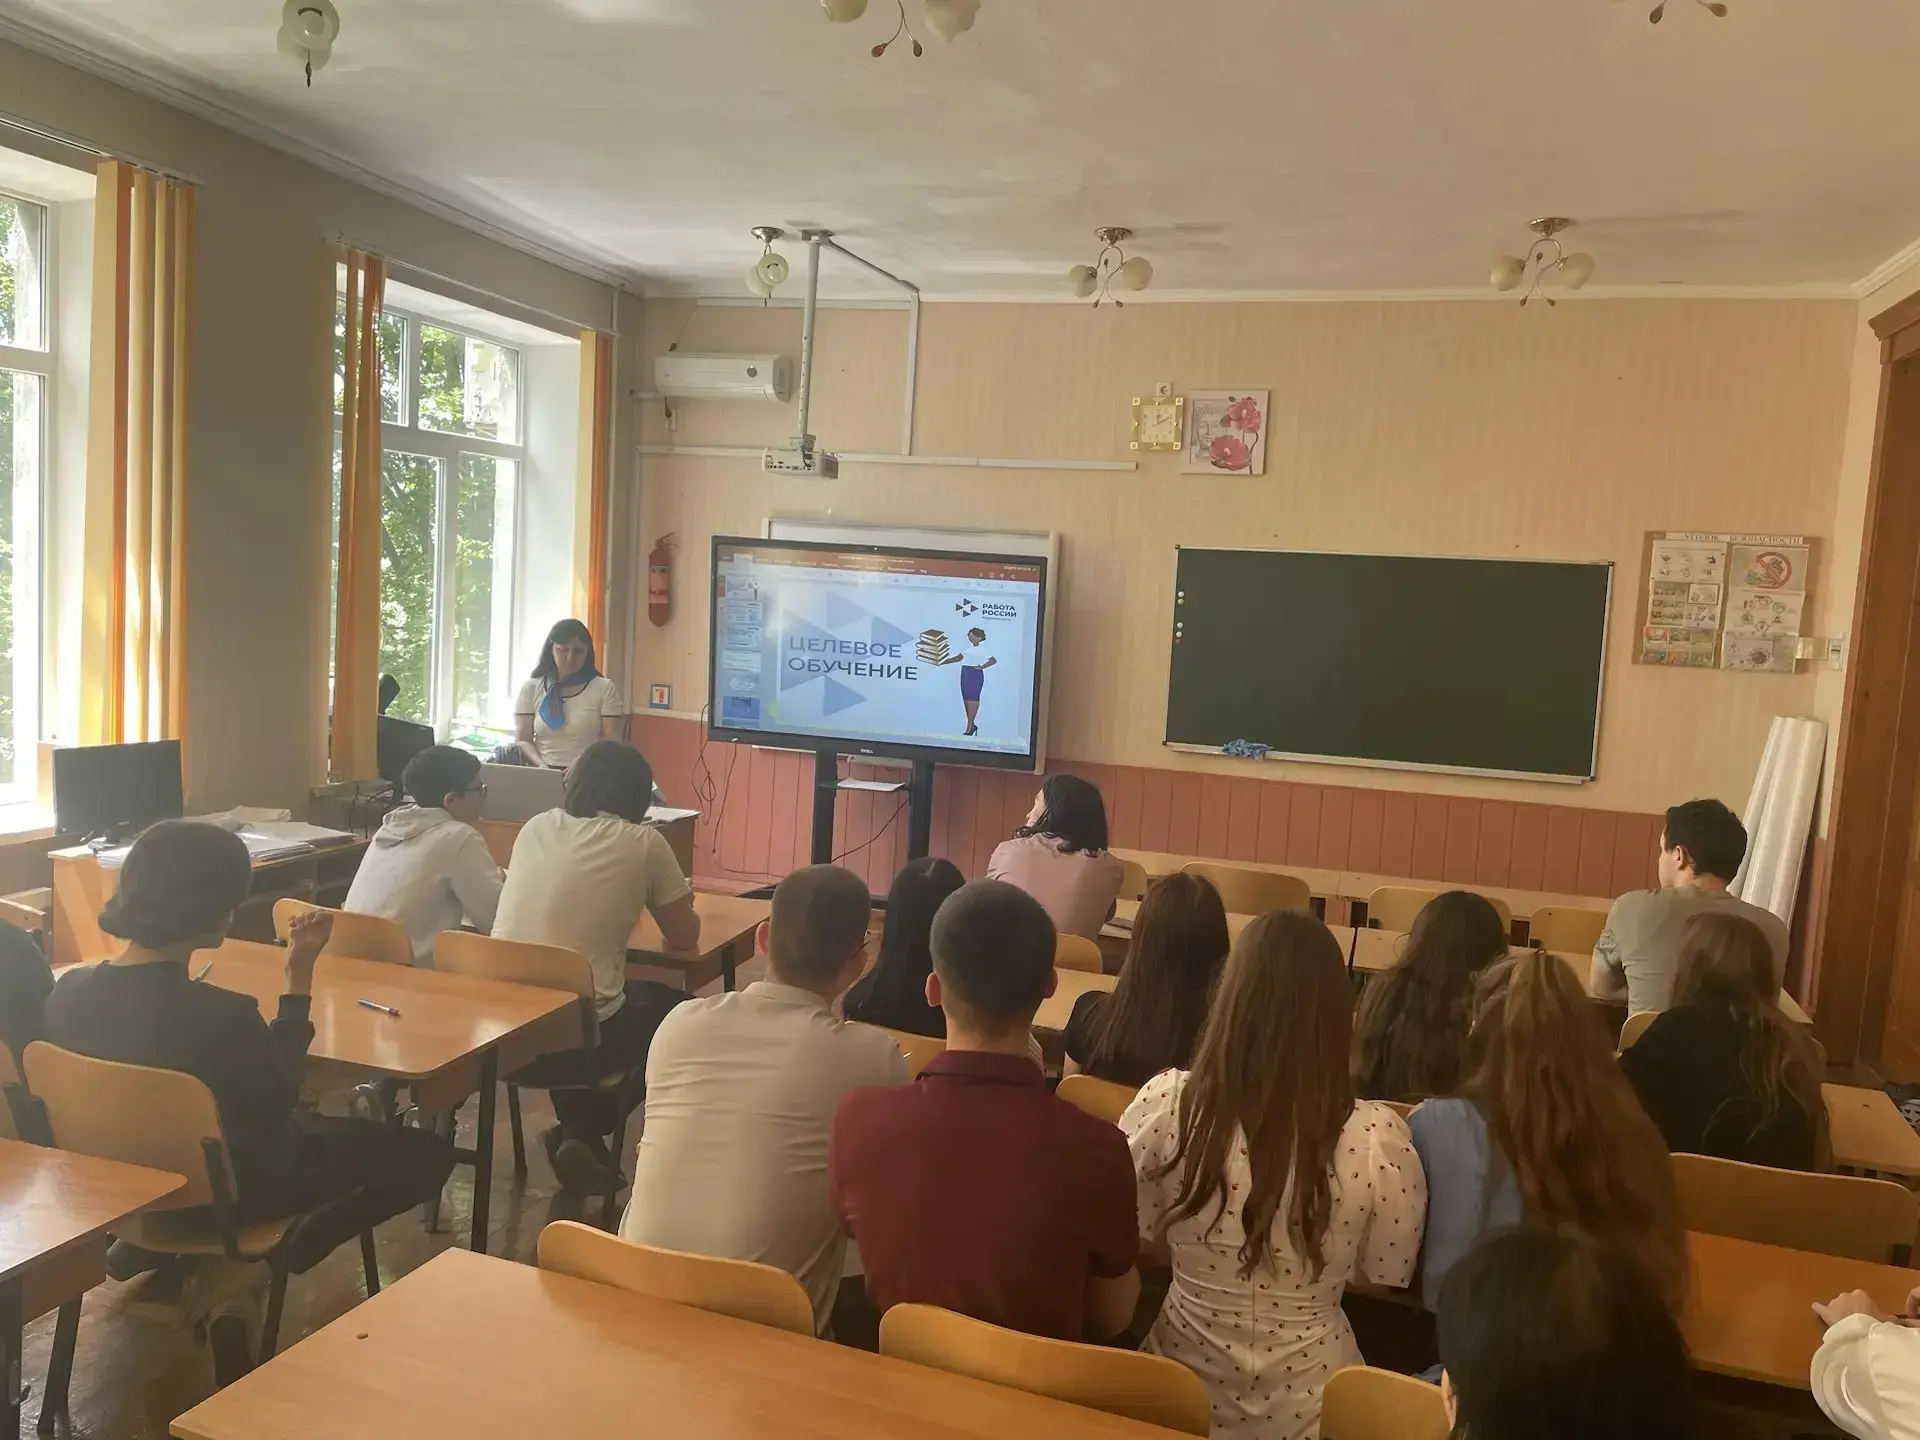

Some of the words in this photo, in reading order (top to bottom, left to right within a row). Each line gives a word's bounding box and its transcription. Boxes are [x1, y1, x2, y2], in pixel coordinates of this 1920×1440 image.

[982, 603, 1016, 611] РАБОТА
[982, 609, 1017, 618] РОССИИ
[789, 636, 902, 660] ЦЕЛЕВОЕ
[788, 657, 918, 681] ОБУЧЕНИЕ
